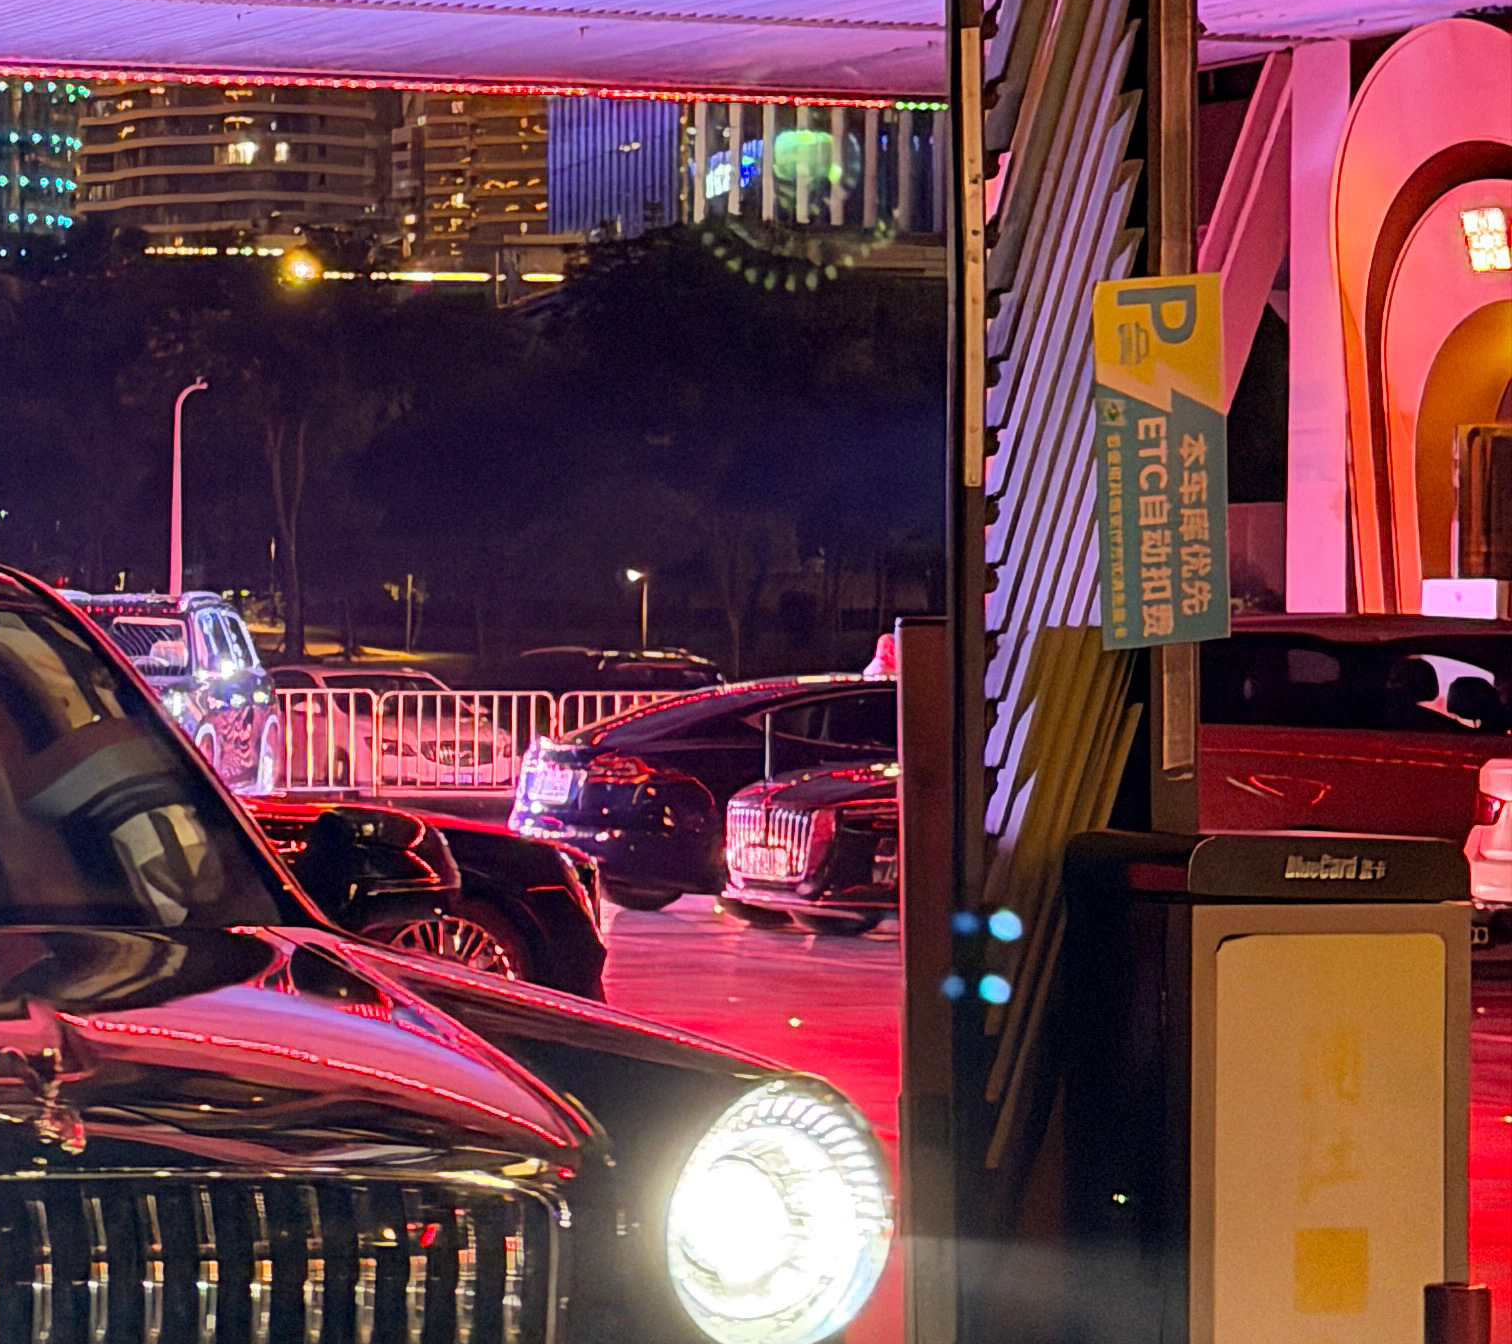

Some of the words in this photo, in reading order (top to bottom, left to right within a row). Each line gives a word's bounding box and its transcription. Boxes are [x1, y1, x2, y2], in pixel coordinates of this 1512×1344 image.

[1117, 285, 1197, 344] P
[1138, 416, 1175, 638] ETC自动扣费
[1179, 432, 1213, 617] 本车库优先
